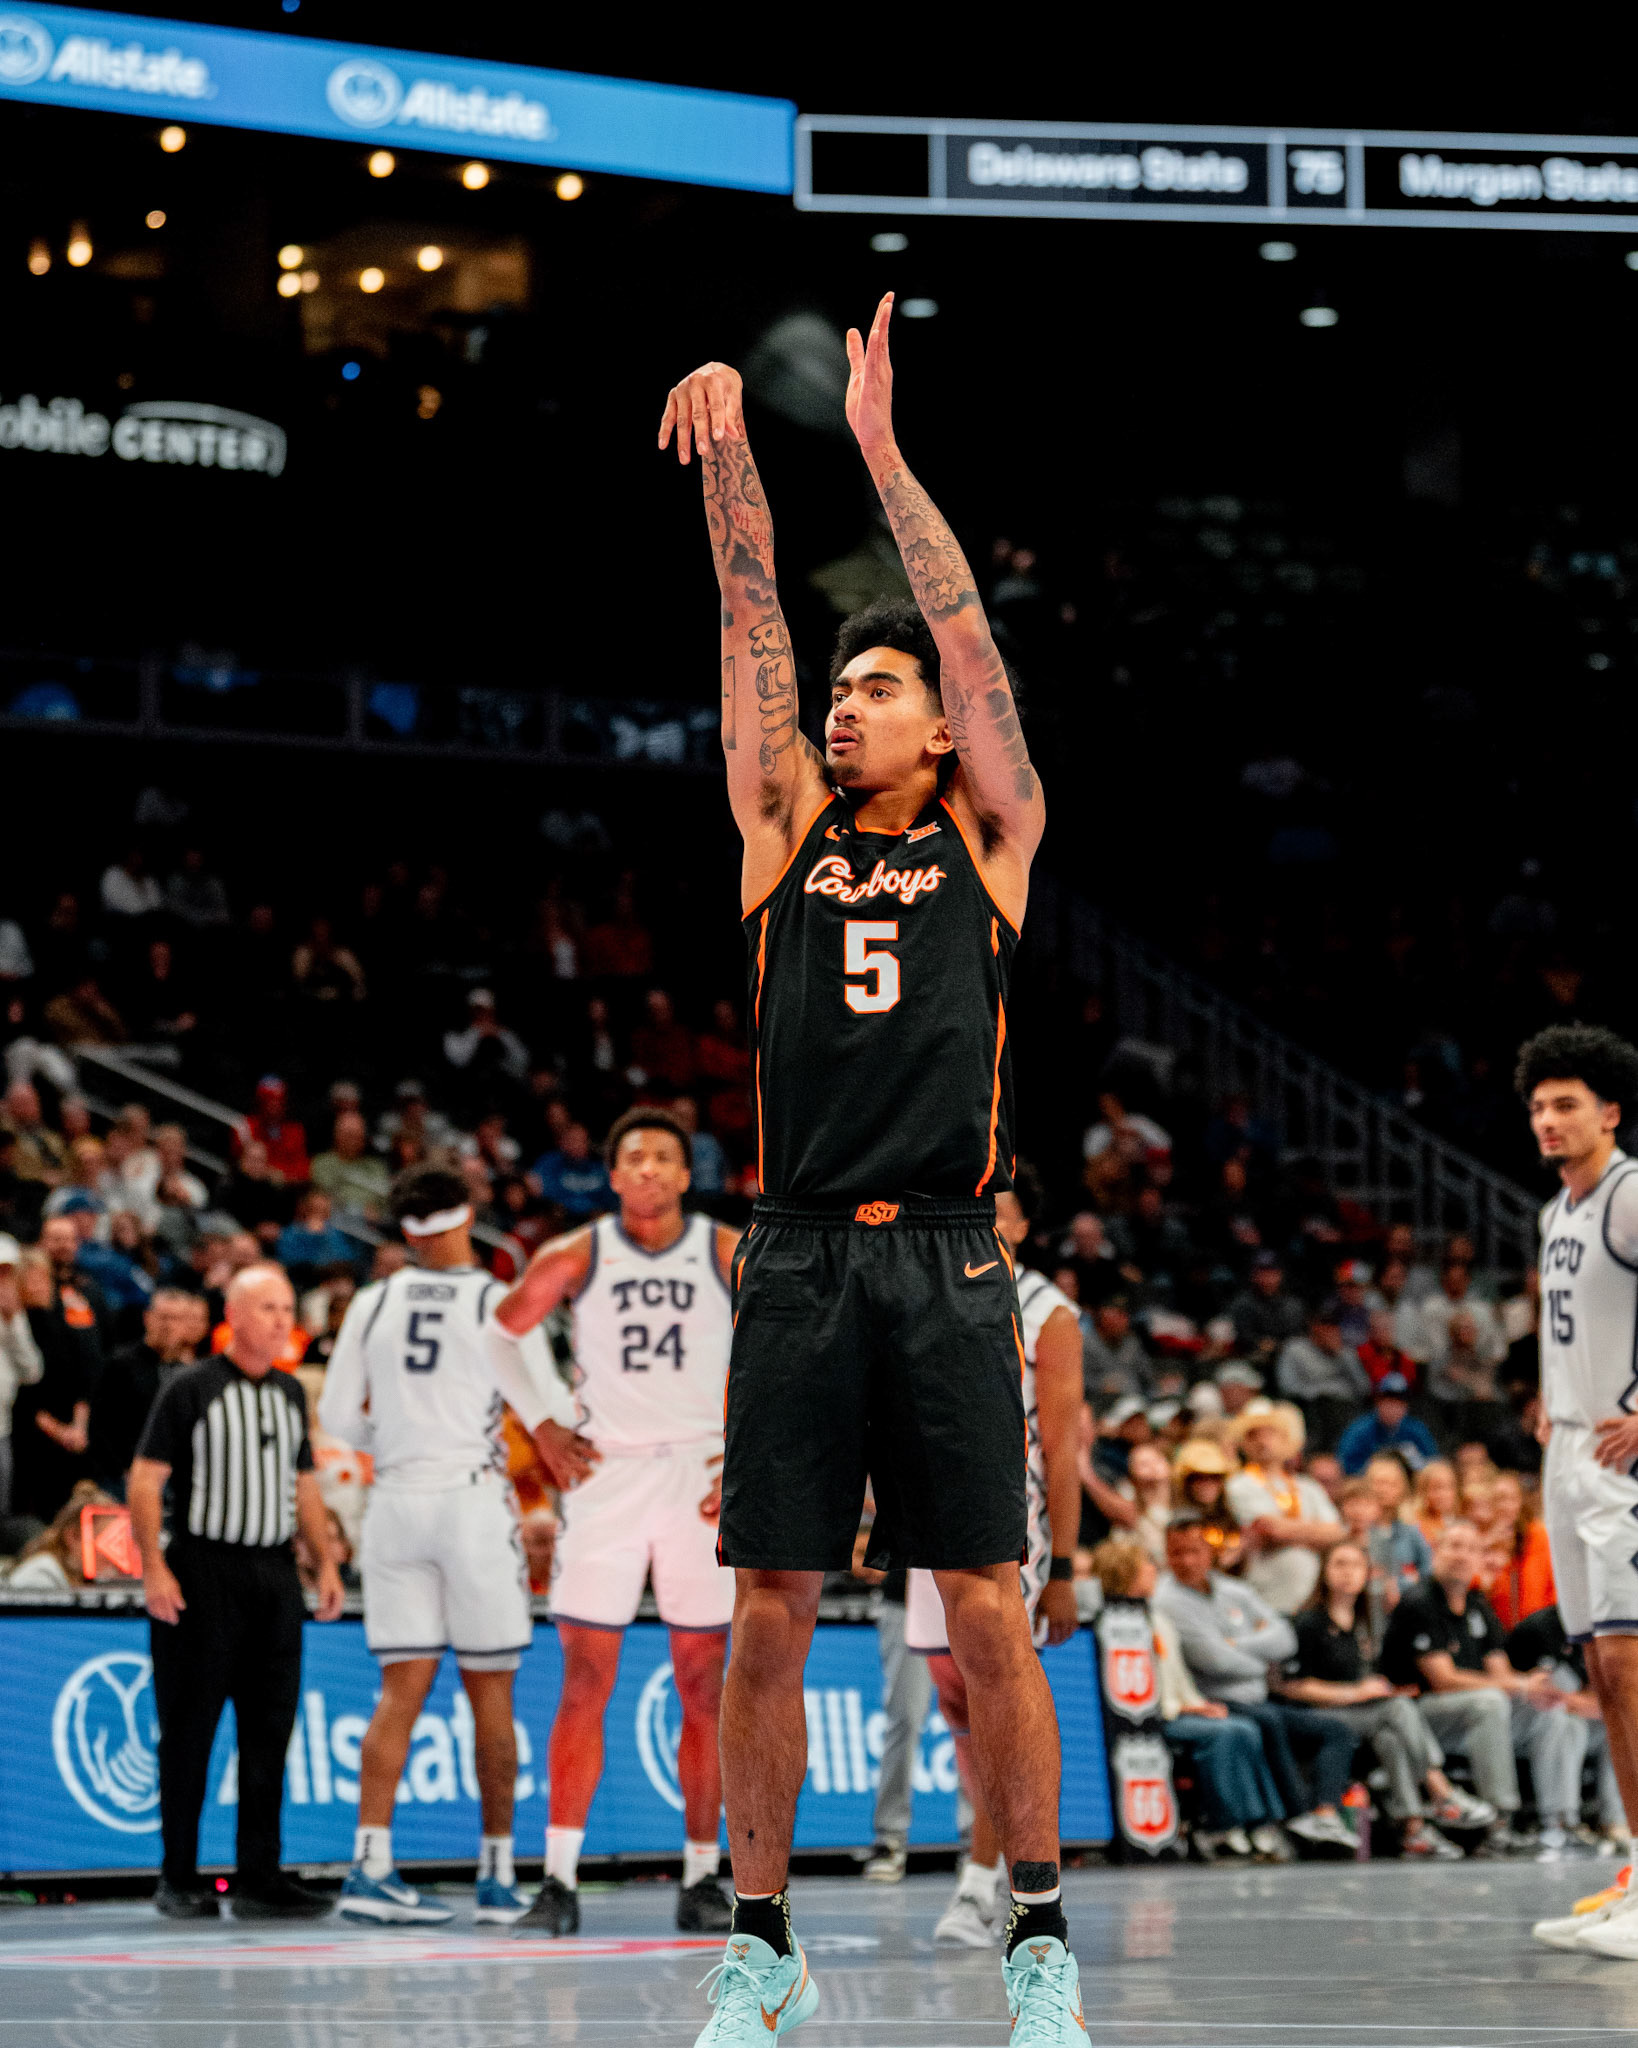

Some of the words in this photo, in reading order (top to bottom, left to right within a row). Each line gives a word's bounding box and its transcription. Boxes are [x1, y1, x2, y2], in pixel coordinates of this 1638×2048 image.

[49, 35, 209, 99] Allstate
[397, 80, 551, 142] Allstate
[968, 142, 1140, 190] Delaware
[1141, 147, 1248, 192] State
[1289, 150, 1344, 194] 75
[1399, 153, 1542, 206] Morgan
[0, 394, 111, 457] obile
[113, 416, 268, 472] CENTER
[804, 855, 947, 904] Cowboys
[844, 920, 900, 1014] 5
[855, 1201, 899, 1225] OSU
[611, 1278, 696, 1312] TCU
[1548, 1289, 1575, 1346] 15
[405, 1311, 443, 1375] 5
[622, 1322, 686, 1372] 24
[803, 1688, 959, 1794] Allsa
